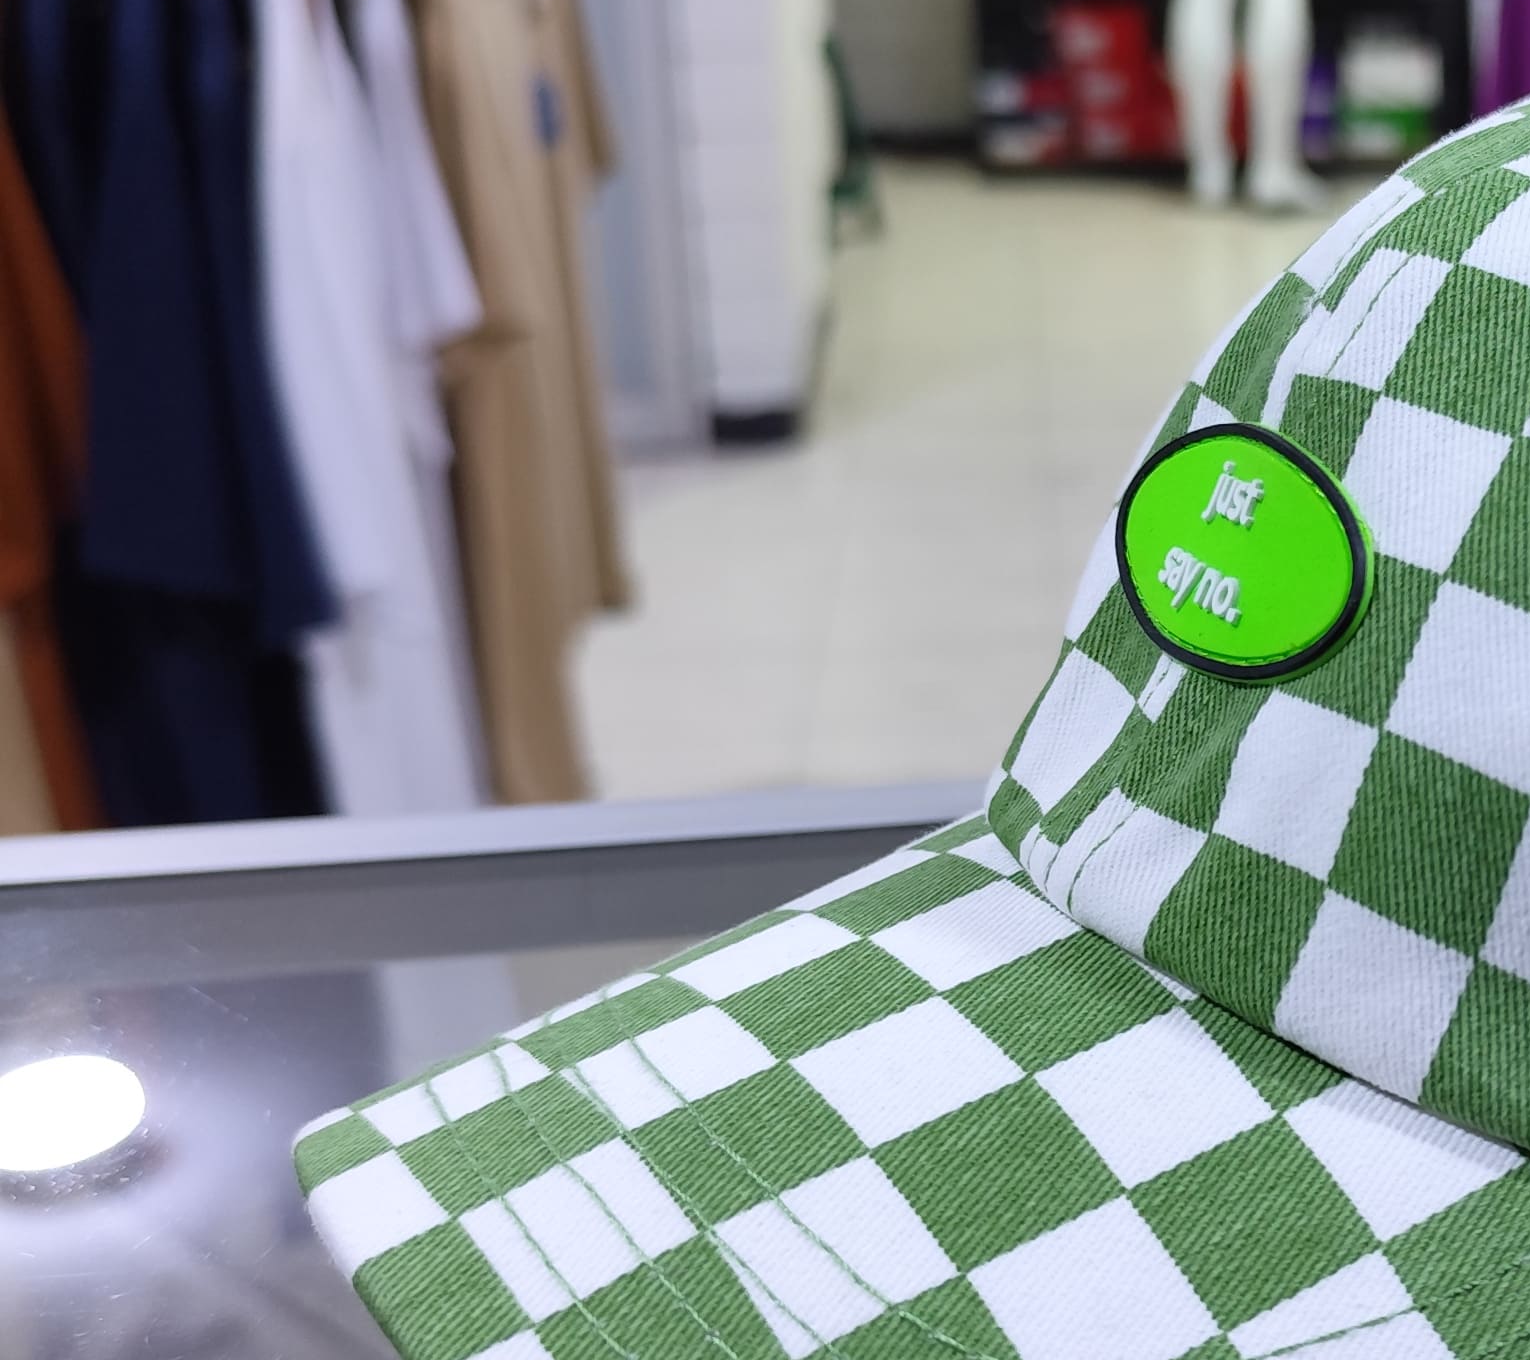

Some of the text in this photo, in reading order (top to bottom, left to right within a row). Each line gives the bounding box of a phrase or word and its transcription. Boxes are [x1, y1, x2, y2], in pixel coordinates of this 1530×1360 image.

[1201, 460, 1265, 530] just
[1157, 545, 1243, 627] say no.
